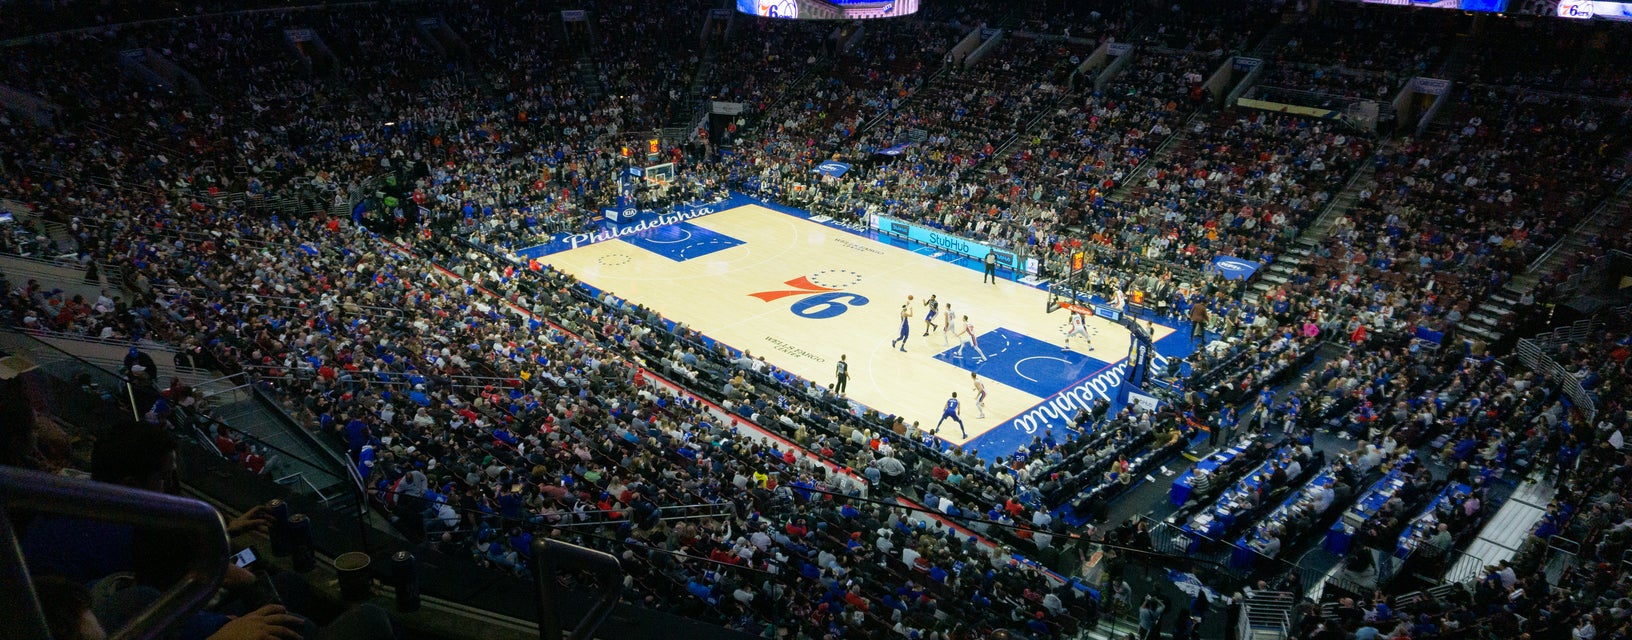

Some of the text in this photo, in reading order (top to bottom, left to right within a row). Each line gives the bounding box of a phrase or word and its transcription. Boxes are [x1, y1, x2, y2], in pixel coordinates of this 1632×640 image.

[562, 206, 714, 248] Philadelphia
[929, 232, 970, 253] StubHub
[747, 276, 869, 319] 76
[765, 336, 795, 350] WELLS
[1014, 348, 1170, 434] Padelphia
